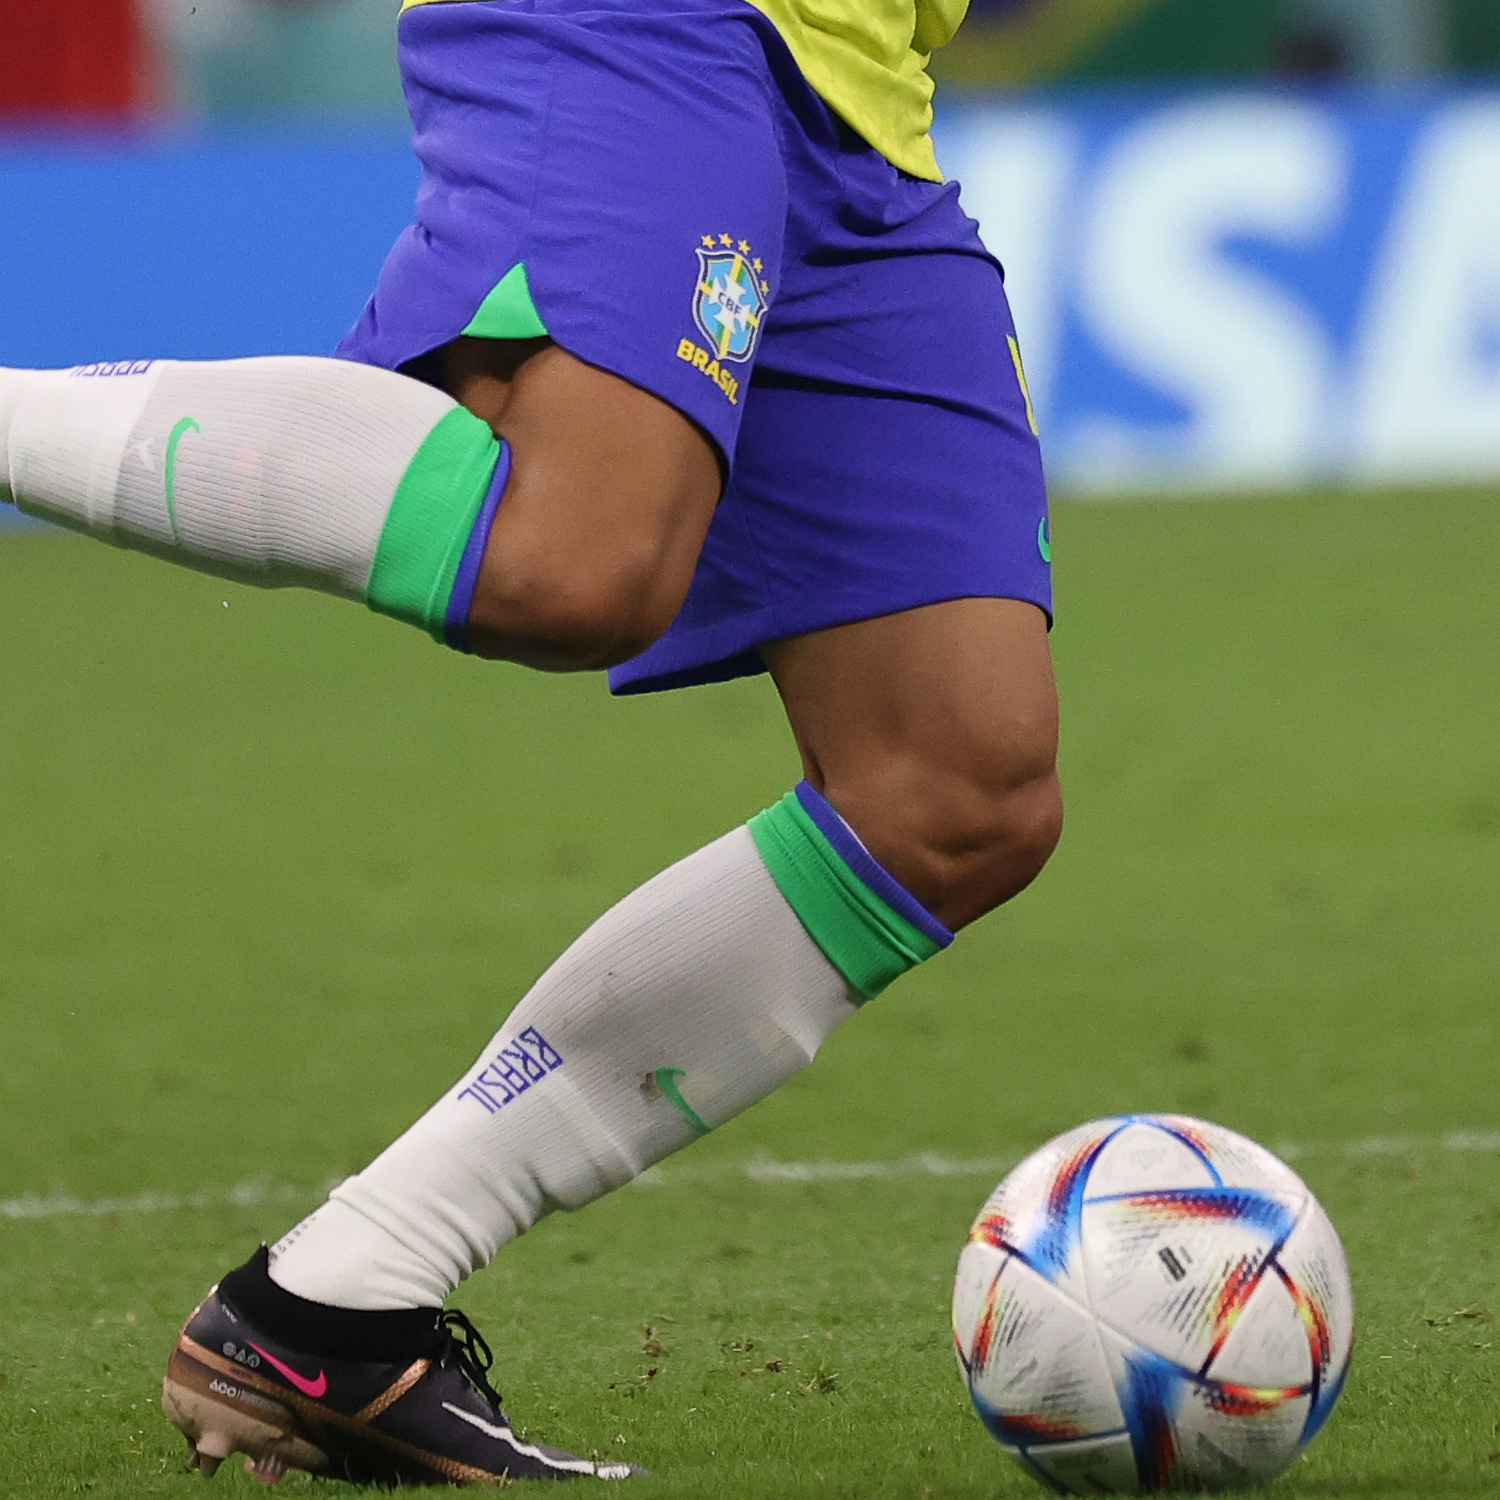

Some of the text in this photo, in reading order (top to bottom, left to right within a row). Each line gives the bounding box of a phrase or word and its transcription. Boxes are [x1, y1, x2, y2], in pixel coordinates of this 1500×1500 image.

[717, 291, 743, 316] CBF
[675, 337, 739, 406] BRASIL
[457, 1025, 564, 1115] BRASIL
